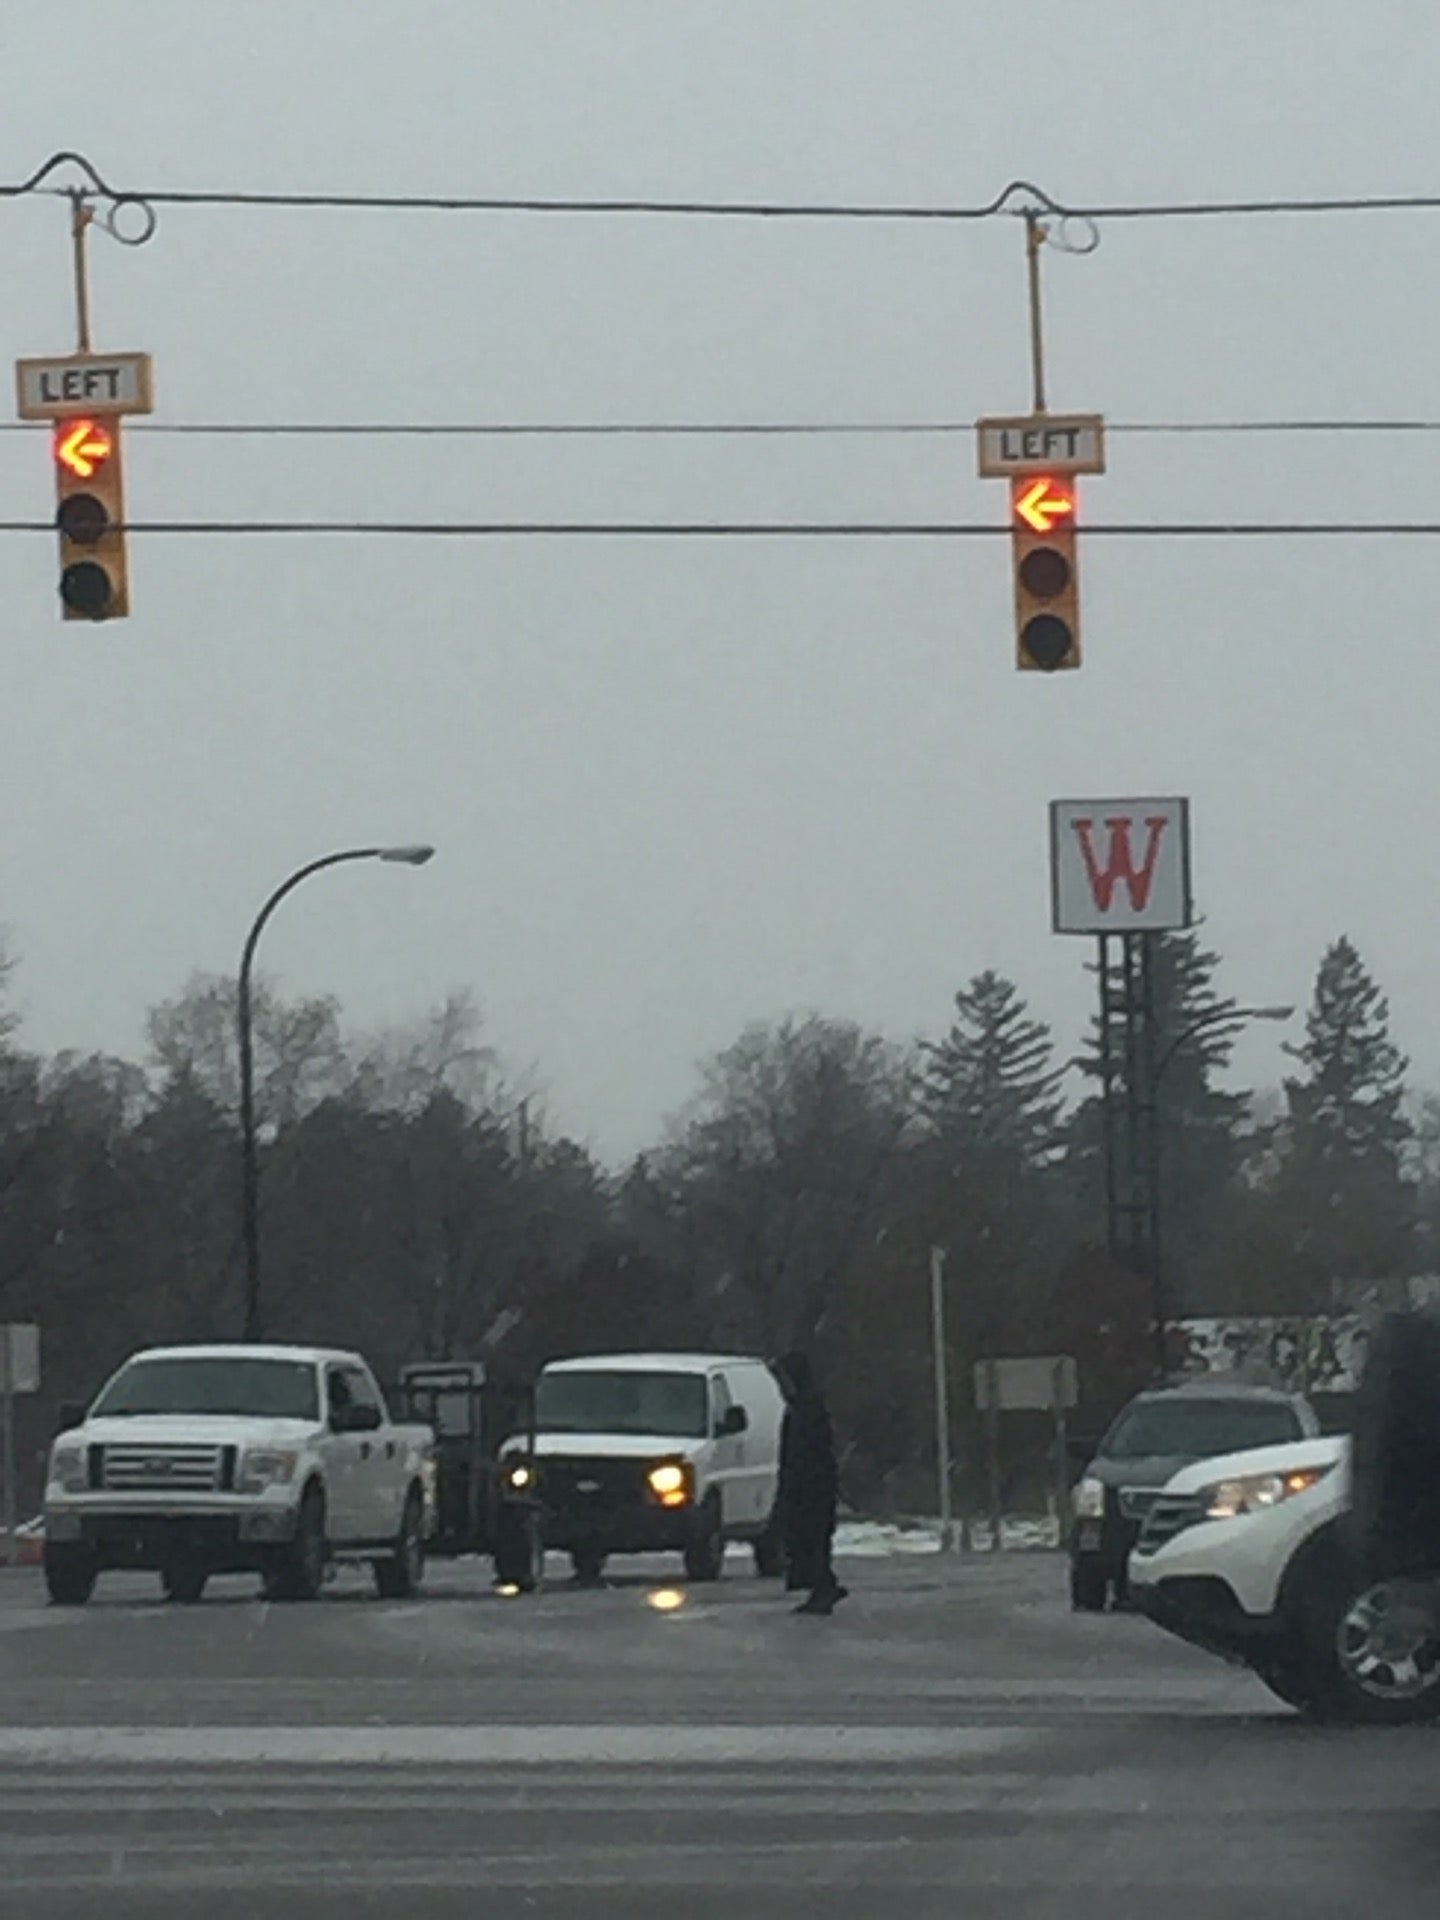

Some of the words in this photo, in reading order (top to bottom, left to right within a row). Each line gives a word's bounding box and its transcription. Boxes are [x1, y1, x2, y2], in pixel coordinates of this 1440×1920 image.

[40, 368, 120, 402] LEFT
[1001, 428, 1080, 460] LEFT
[1070, 817, 1168, 912] W
